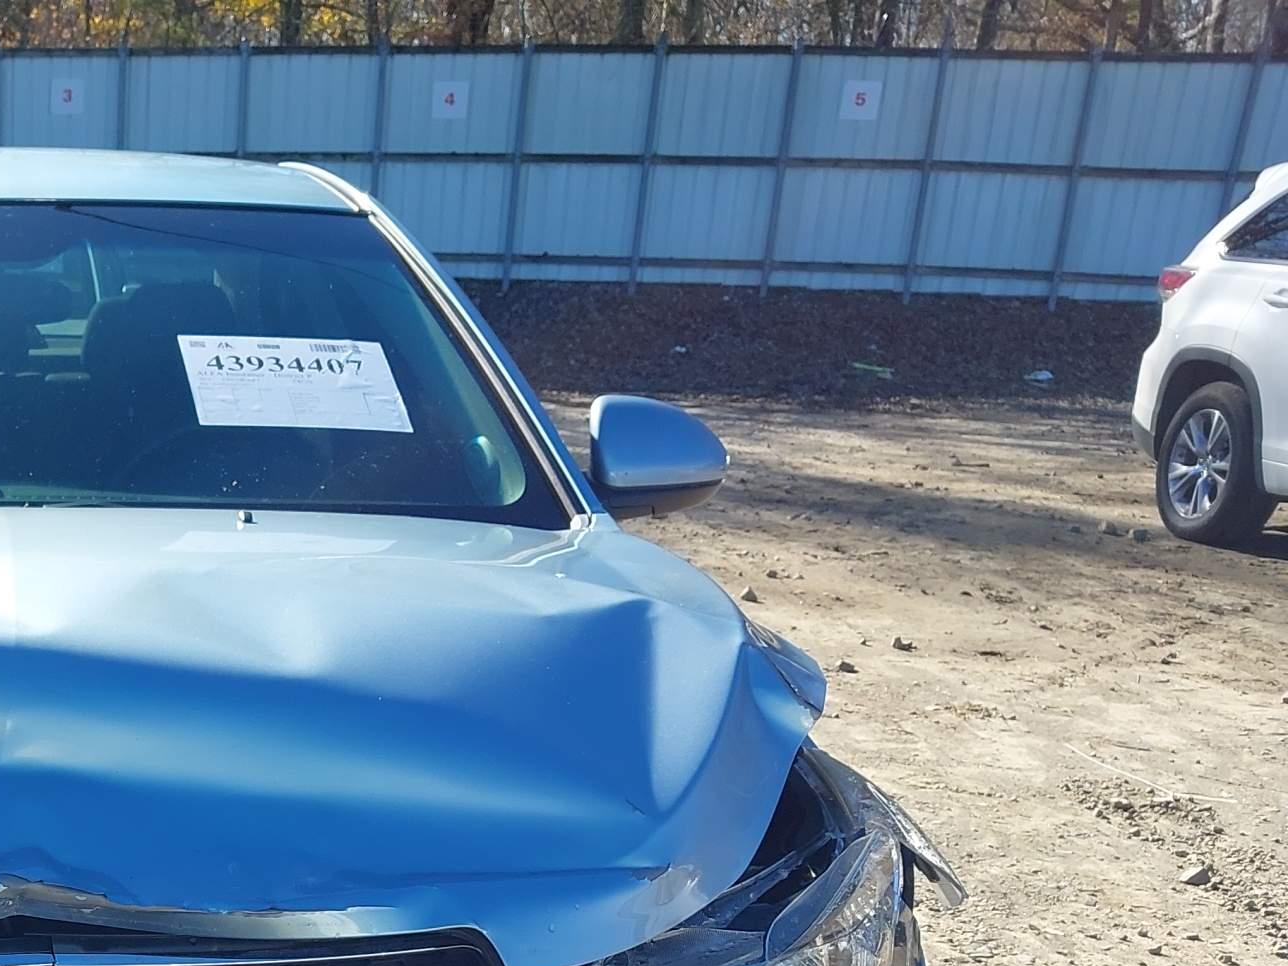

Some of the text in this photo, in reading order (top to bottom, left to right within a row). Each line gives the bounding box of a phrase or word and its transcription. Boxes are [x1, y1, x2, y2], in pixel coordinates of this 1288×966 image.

[63, 88, 73, 103] 3
[444, 91, 456, 106] 4
[855, 91, 867, 107] 5
[206, 355, 363, 376] 43934407
